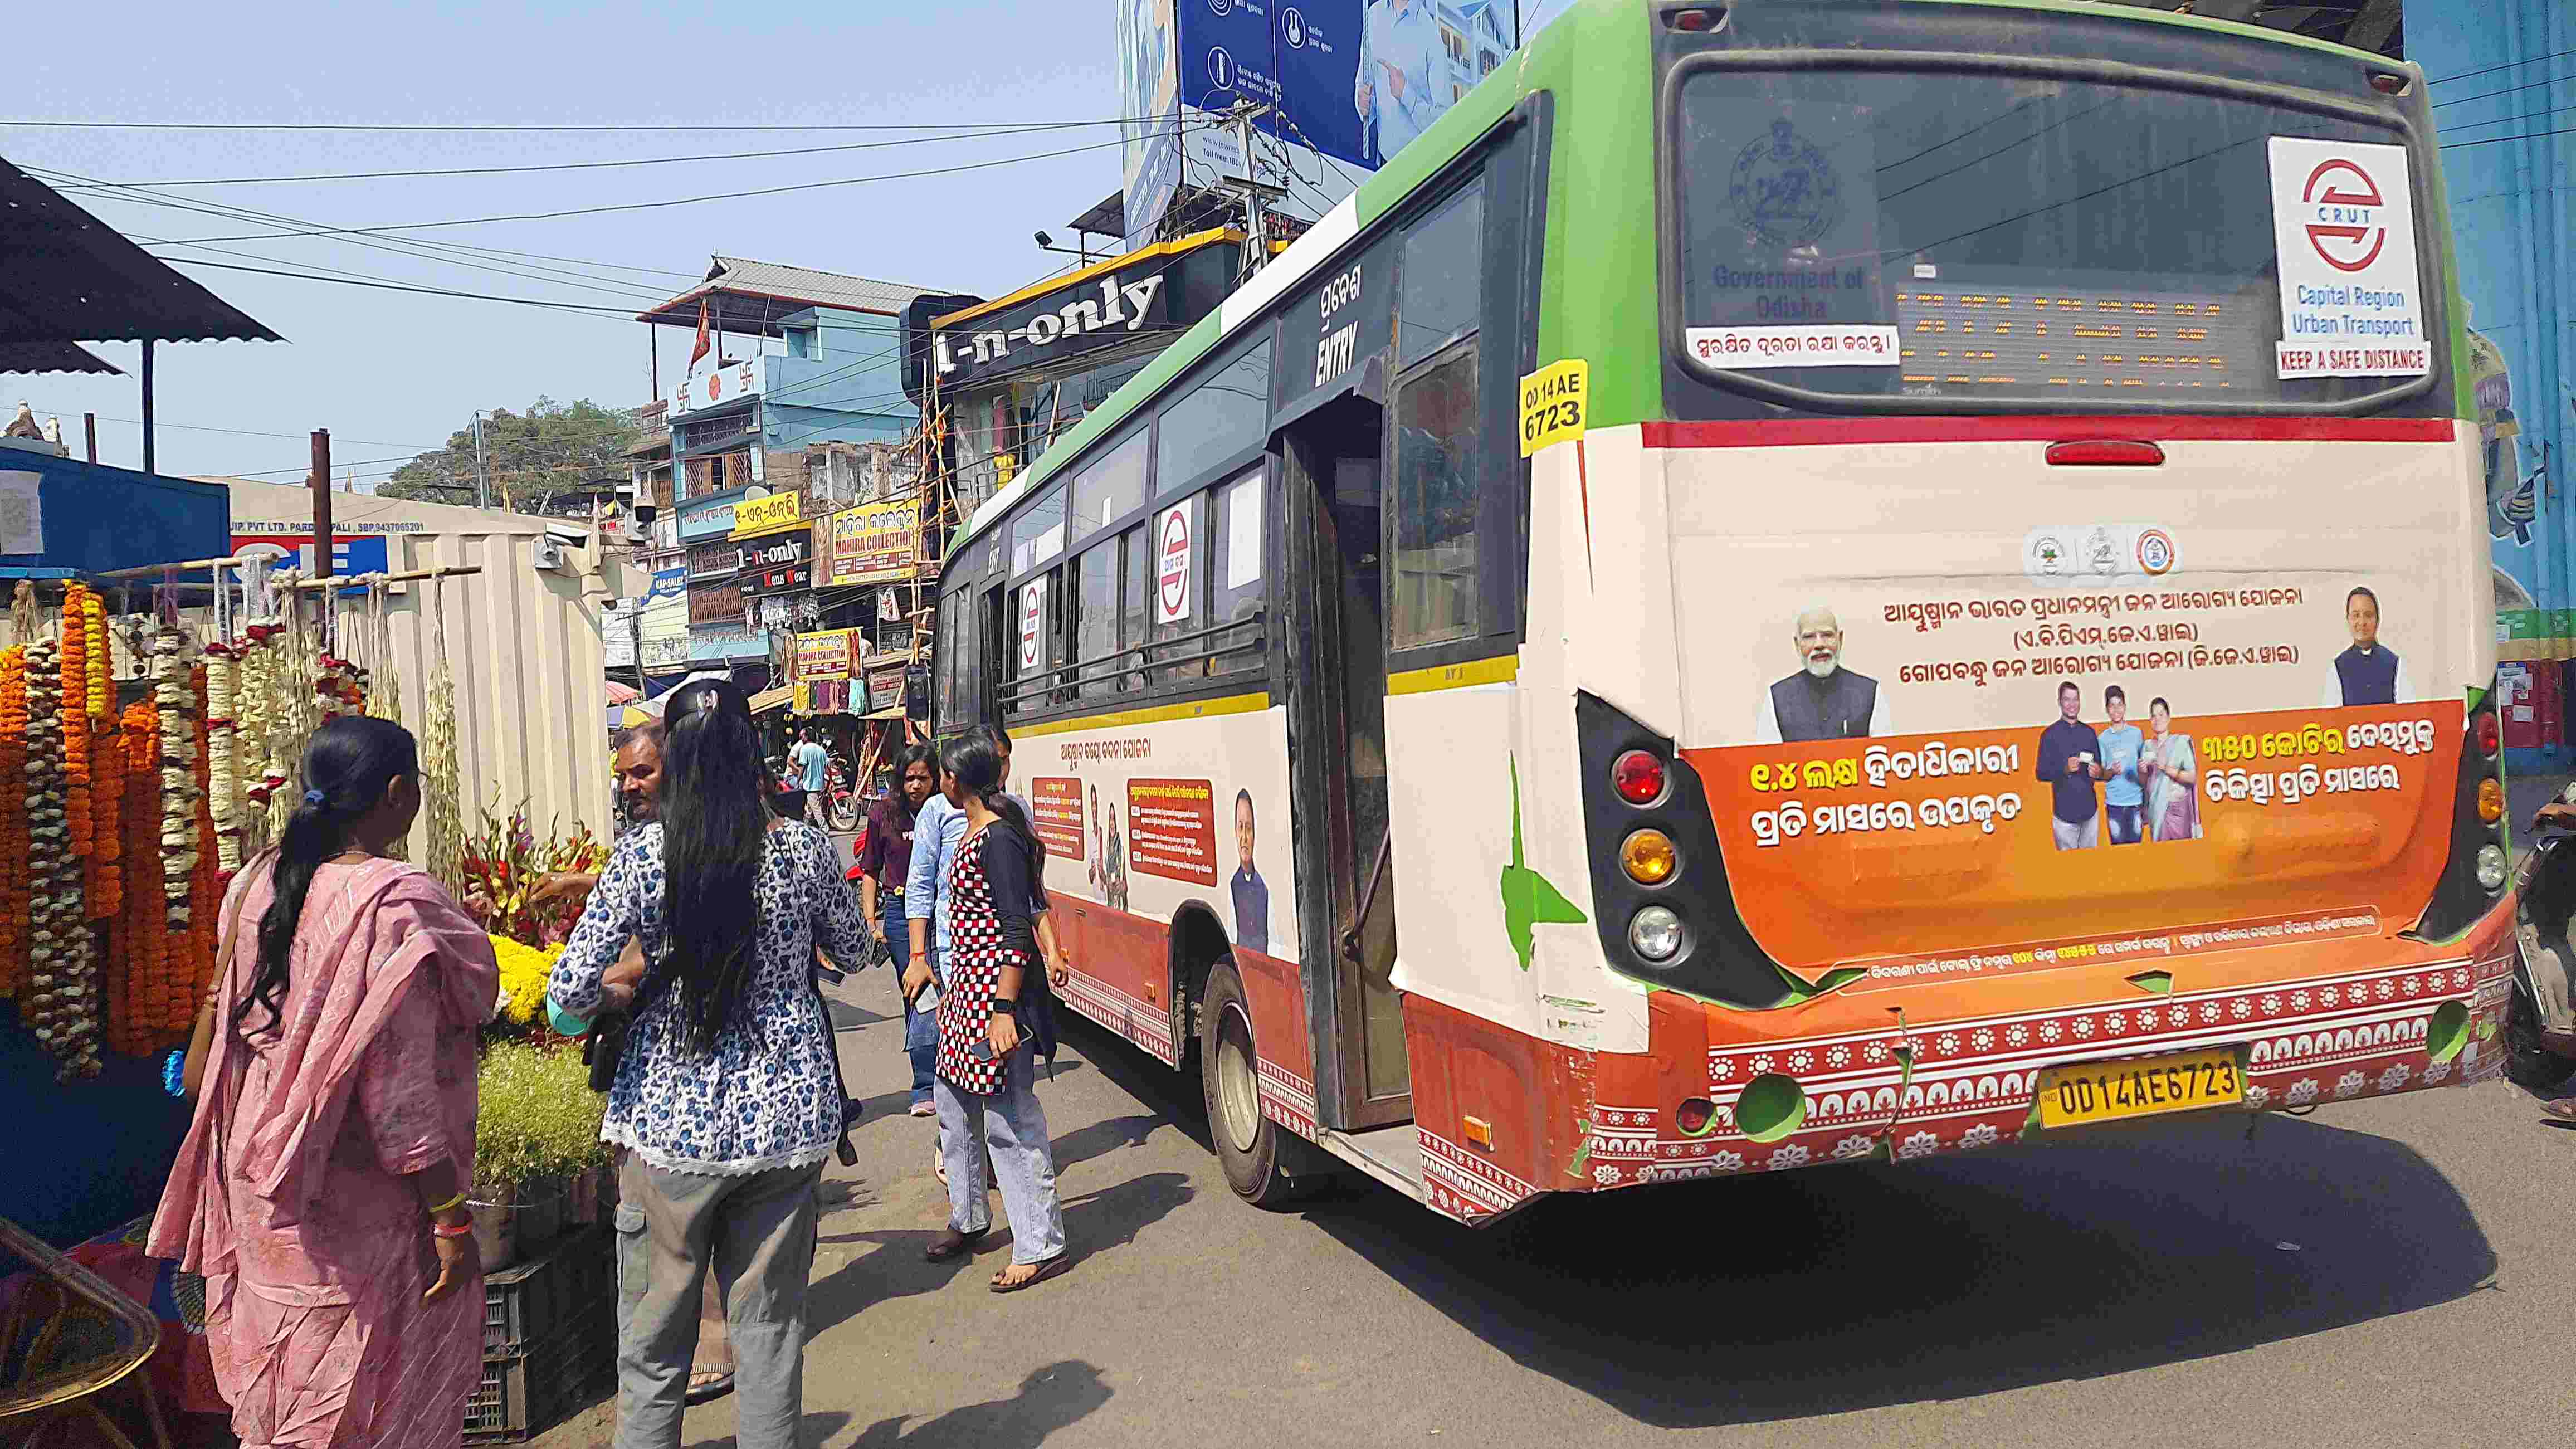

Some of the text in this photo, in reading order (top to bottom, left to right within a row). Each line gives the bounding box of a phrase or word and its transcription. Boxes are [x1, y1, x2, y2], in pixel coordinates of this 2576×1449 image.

[2317, 207, 2372, 223] CRUT
[1712, 266, 1865, 289] Government of
[1320, 264, 1363, 333] ପ୍ରବେଶ
[1755, 295, 1827, 319] Odisha
[2297, 285, 2406, 311] Capital Region
[2292, 314, 2414, 339] Urban Transport
[1315, 321, 1358, 387] ENTRY
[2281, 350, 2425, 370] KEEP A SAFE DISTANCE
[1541, 379, 1553, 402] 14
[1557, 373, 1579, 396] AE
[1525, 401, 1580, 441] 6723
[248, 521, 265, 532] PVT
[836, 530, 911, 555] MAHIRA COLLECTIO
[764, 569, 807, 588] Mens Wear
[1884, 587, 2303, 632] ଆୟୁଷ୍ମାନ ଭାରତ ପ୍ରଧାନମନ୍ତ୍ରୀ ଜନ ଆରୋଗ୍ୟ ଯୋଜନା
[798, 650, 846, 661] MAHIRA COLLECTION
[1899, 660, 1987, 686] ଗୋପବନ୍ଧୁ
[1992, 659, 2027, 677] ଜନ
[2032, 655, 2111, 676] ଆରୋଗ୍ୟ
[2116, 650, 2184, 671] ଯୋଜନା
[2261, 723, 2345, 758] କୋଟିର
[1803, 757, 1859, 790] ଲକ୍ଷ
[1864, 740, 2019, 788] ହିତାଧିକାରୀ
[2205, 764, 2401, 805] ଚିକିତ୍ସା ପ୍ରତି ମାସରେ
[1750, 791, 2022, 847] ପ୍ରତି ମାସରେ ଉପକୃତ
[2059, 1060, 2236, 1115] OD14AE6723
